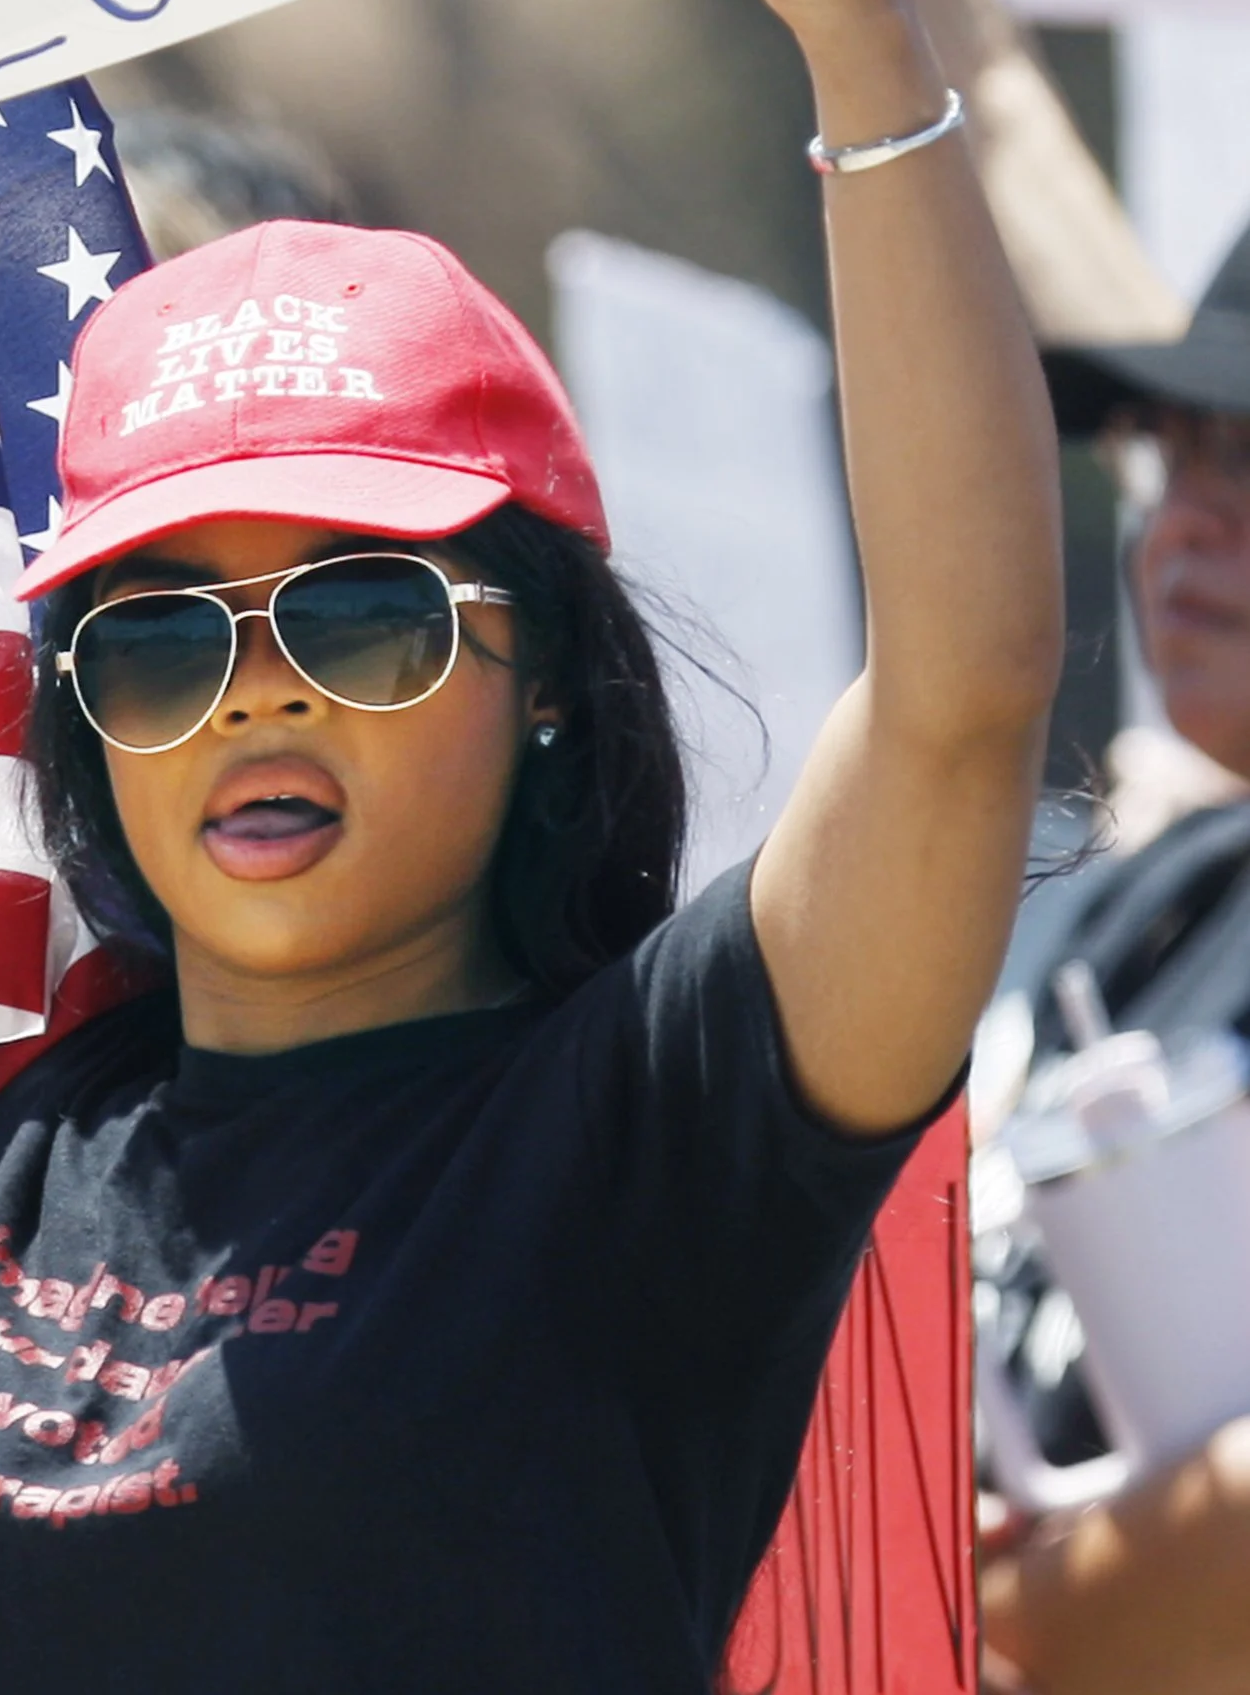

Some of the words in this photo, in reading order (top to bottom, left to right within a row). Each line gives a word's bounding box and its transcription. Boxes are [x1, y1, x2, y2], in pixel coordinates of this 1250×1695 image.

[156, 294, 349, 355] BLACK
[150, 329, 339, 388] LIVES
[118, 365, 385, 437] MATTER
